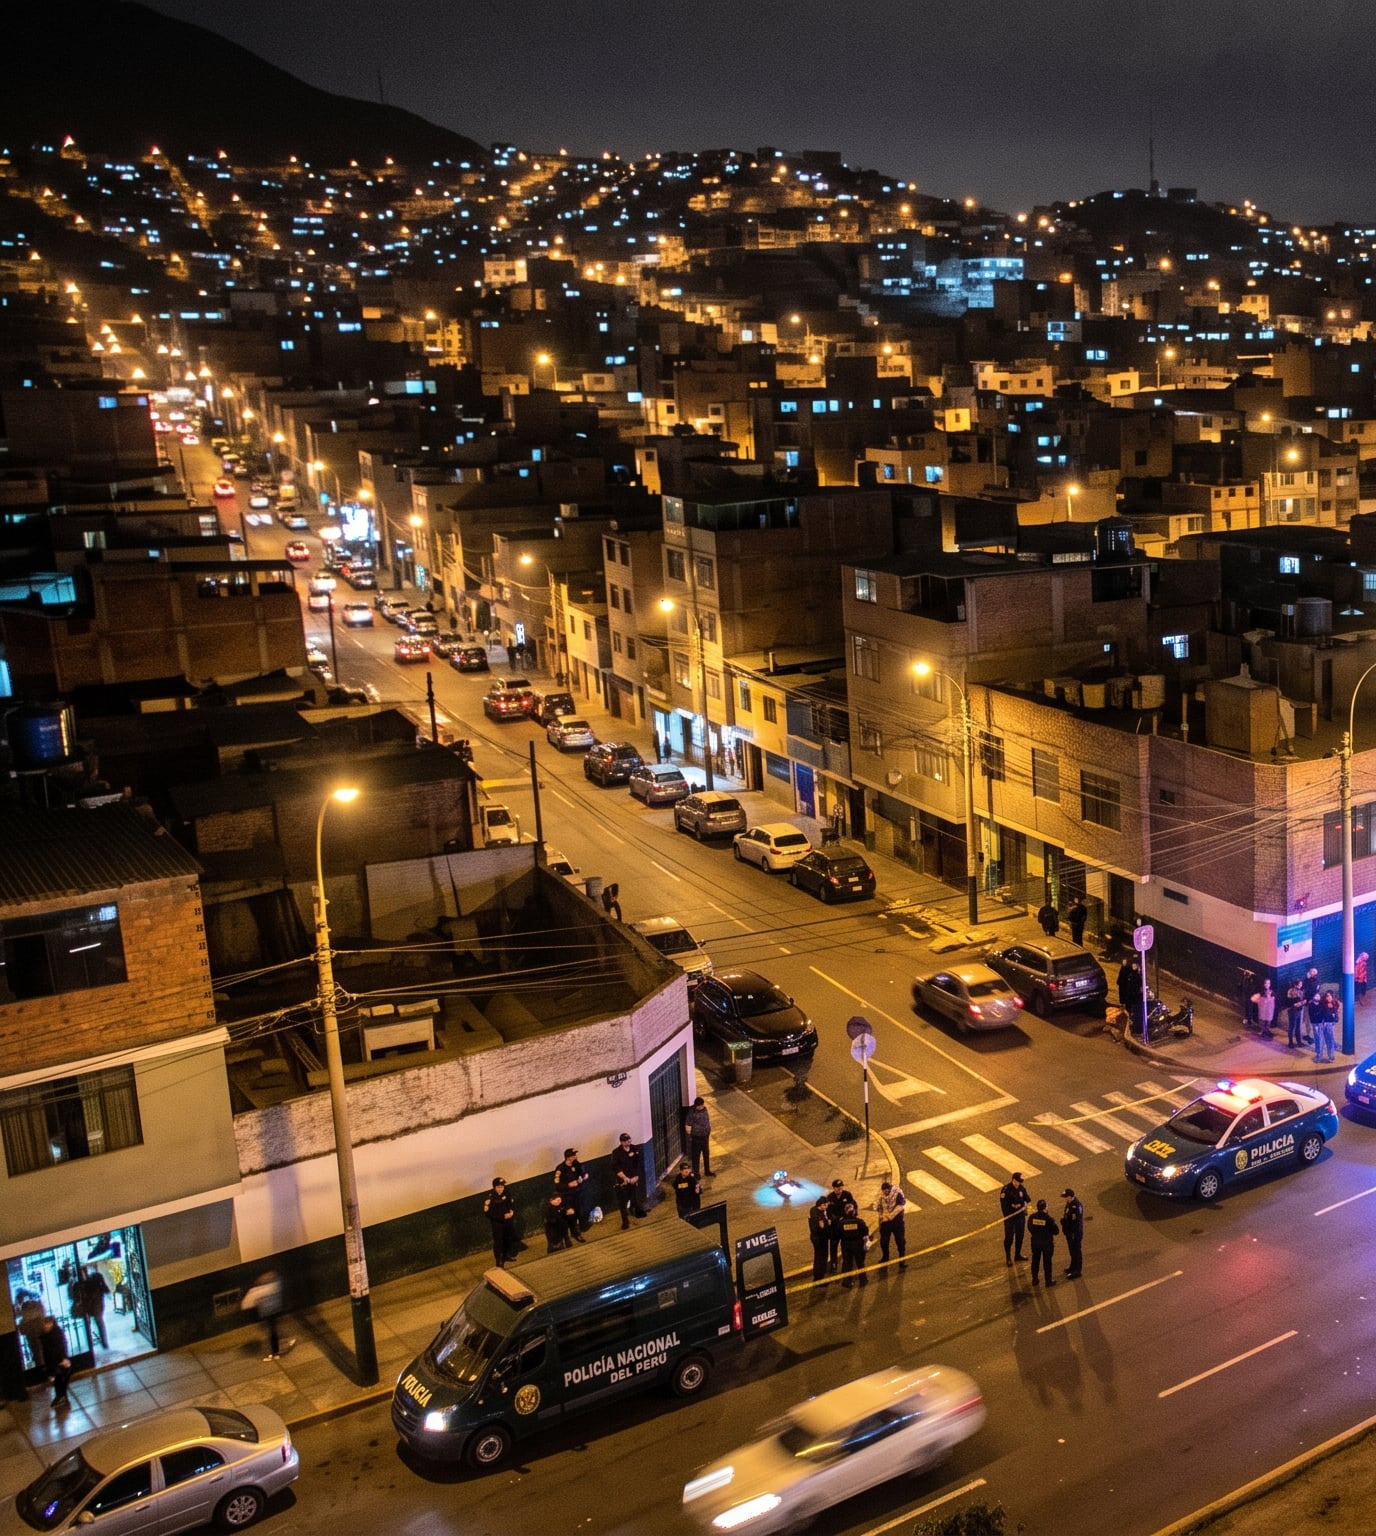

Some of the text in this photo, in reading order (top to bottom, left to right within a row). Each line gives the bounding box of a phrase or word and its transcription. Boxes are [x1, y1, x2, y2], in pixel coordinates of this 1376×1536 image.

[563, 1331, 681, 1388] POLICÍA NACIONAL
[610, 1352, 668, 1384] DEL PERÚ
